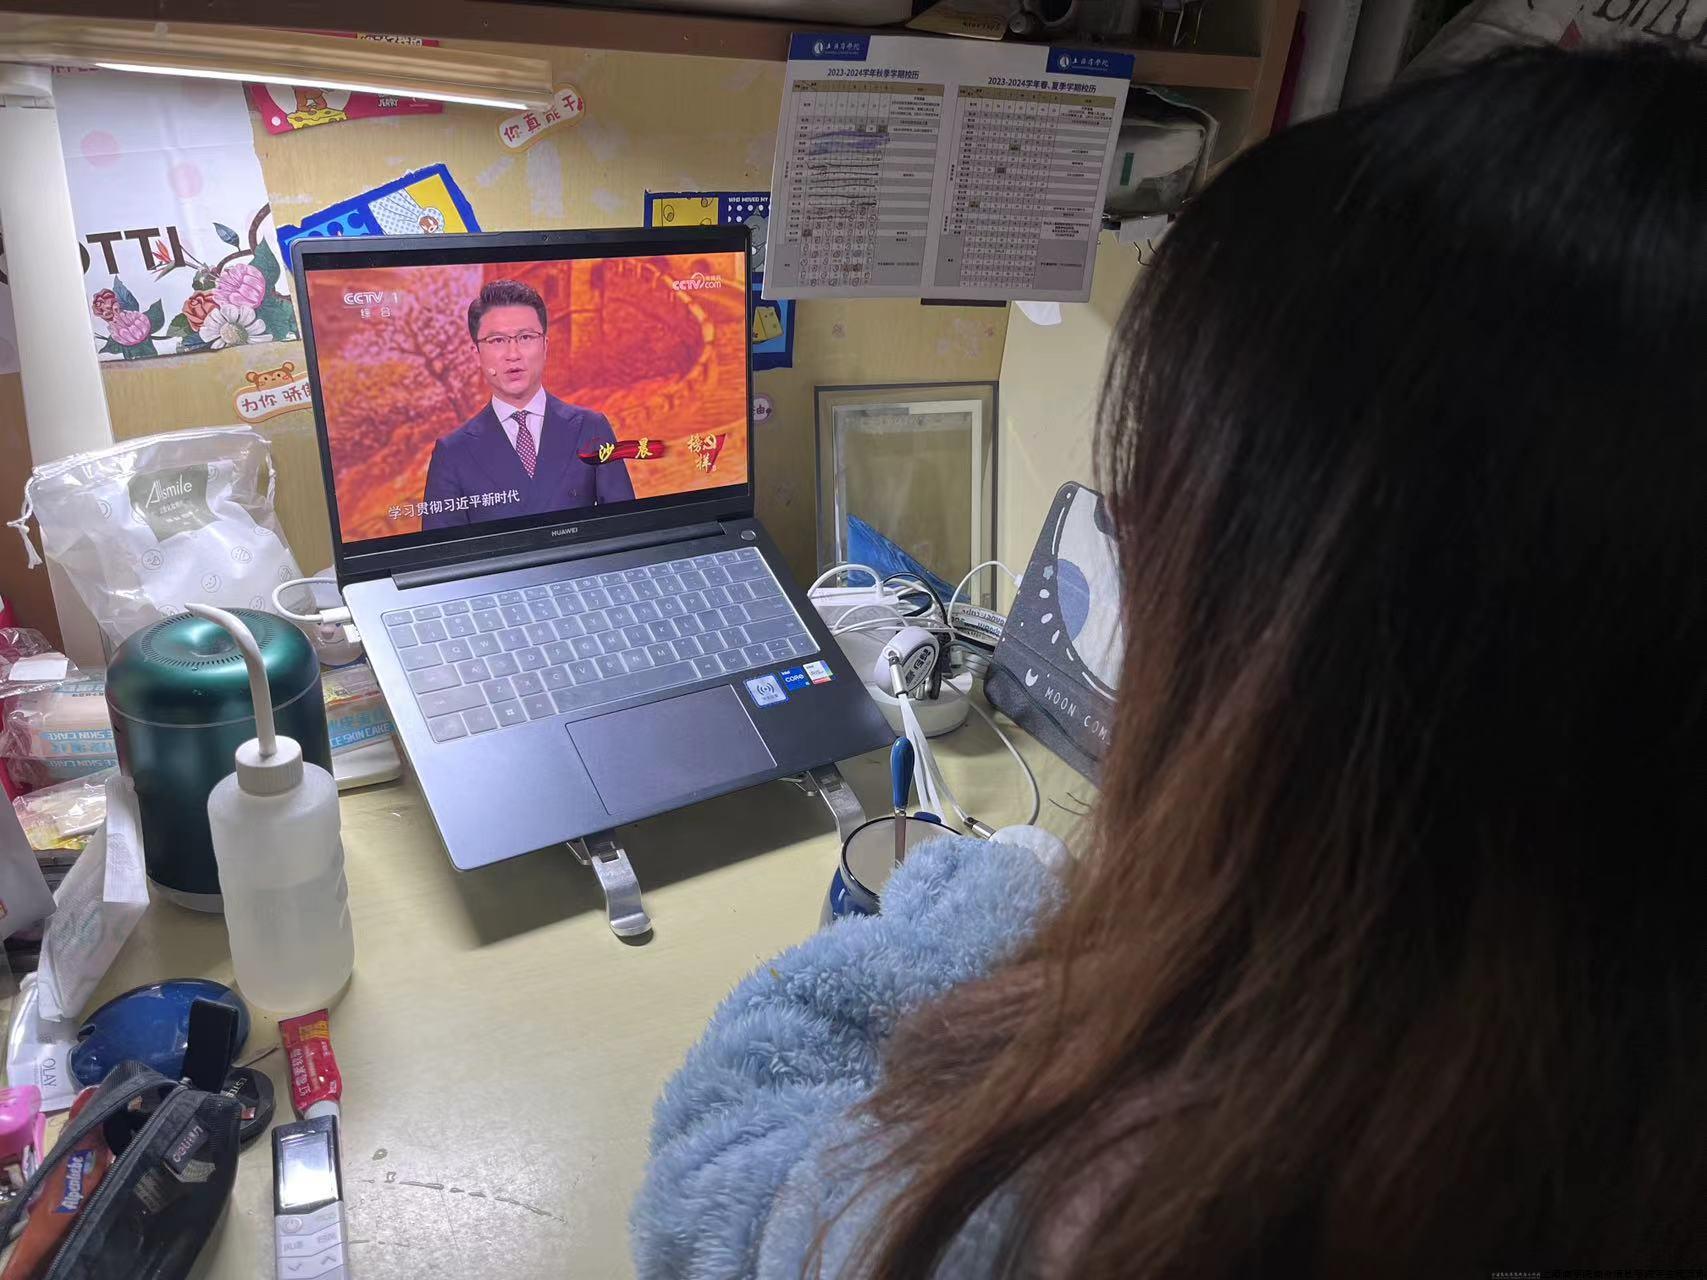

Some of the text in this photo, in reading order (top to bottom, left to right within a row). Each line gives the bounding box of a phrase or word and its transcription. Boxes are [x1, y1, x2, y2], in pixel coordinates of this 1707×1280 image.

[343, 291, 384, 305] CCTV
[388, 488, 521, 520] 学习贯彻习近平新时代
[551, 527, 579, 537] HUAWEI
[1044, 686, 1078, 717] MOON
[42, 1058, 57, 1087] OLAY
